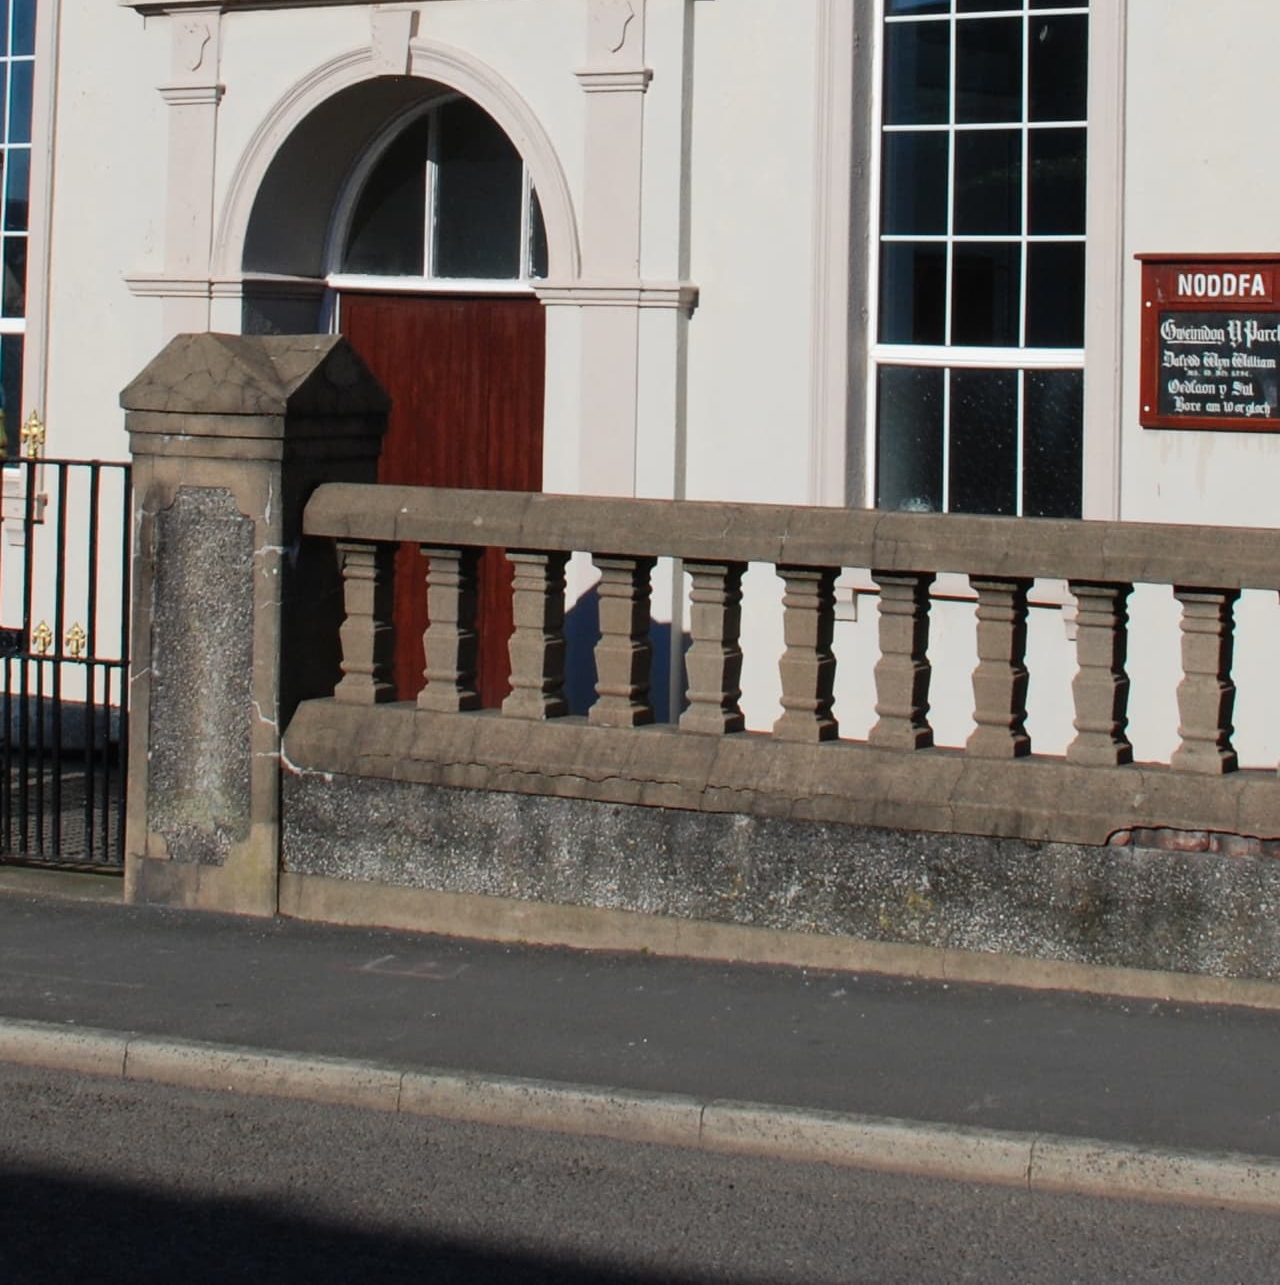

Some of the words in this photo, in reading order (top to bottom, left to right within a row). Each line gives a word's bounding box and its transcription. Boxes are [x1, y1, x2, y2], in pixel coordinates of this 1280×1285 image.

[1177, 273, 1265, 297] NODDFA
[1162, 349, 1200, 370] Dafydd
[1203, 351, 1230, 370] Wyn
[1231, 381, 1255, 396] Sul
[1173, 395, 1202, 412] Bore
[1205, 401, 1221, 412] am
